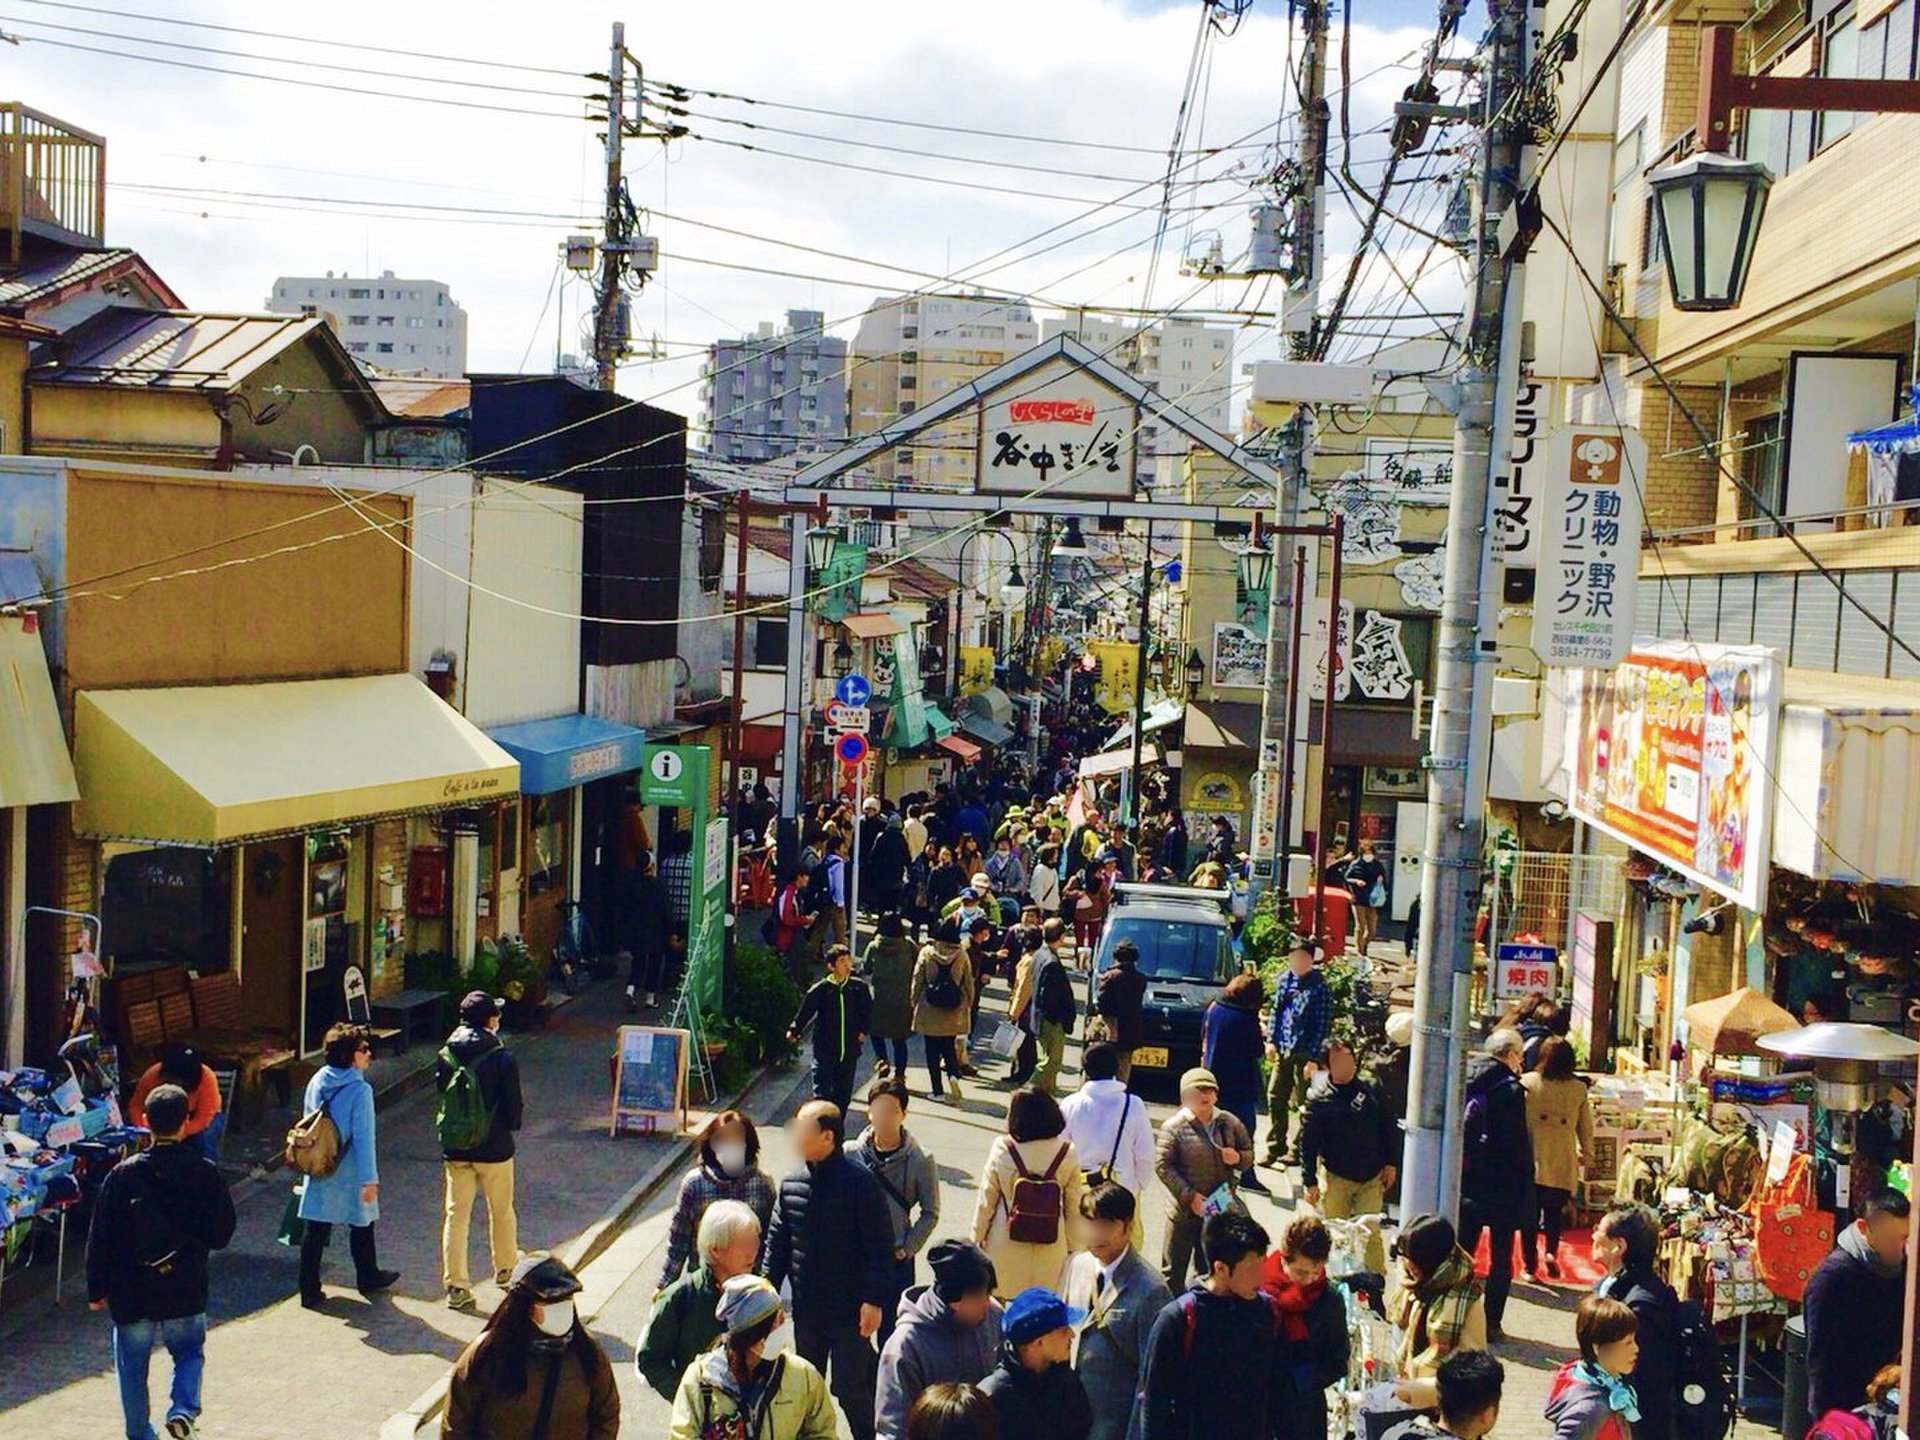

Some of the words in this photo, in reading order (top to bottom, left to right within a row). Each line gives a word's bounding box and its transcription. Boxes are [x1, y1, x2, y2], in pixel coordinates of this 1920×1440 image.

[992, 420, 1124, 481] 谷中ぎんざ
[1557, 489, 1588, 614] クリニック
[1586, 490, 1620, 618] 動物・野沢
[1551, 646, 1611, 660] 3894-7739
[1507, 968, 1548, 987] 焼肉
